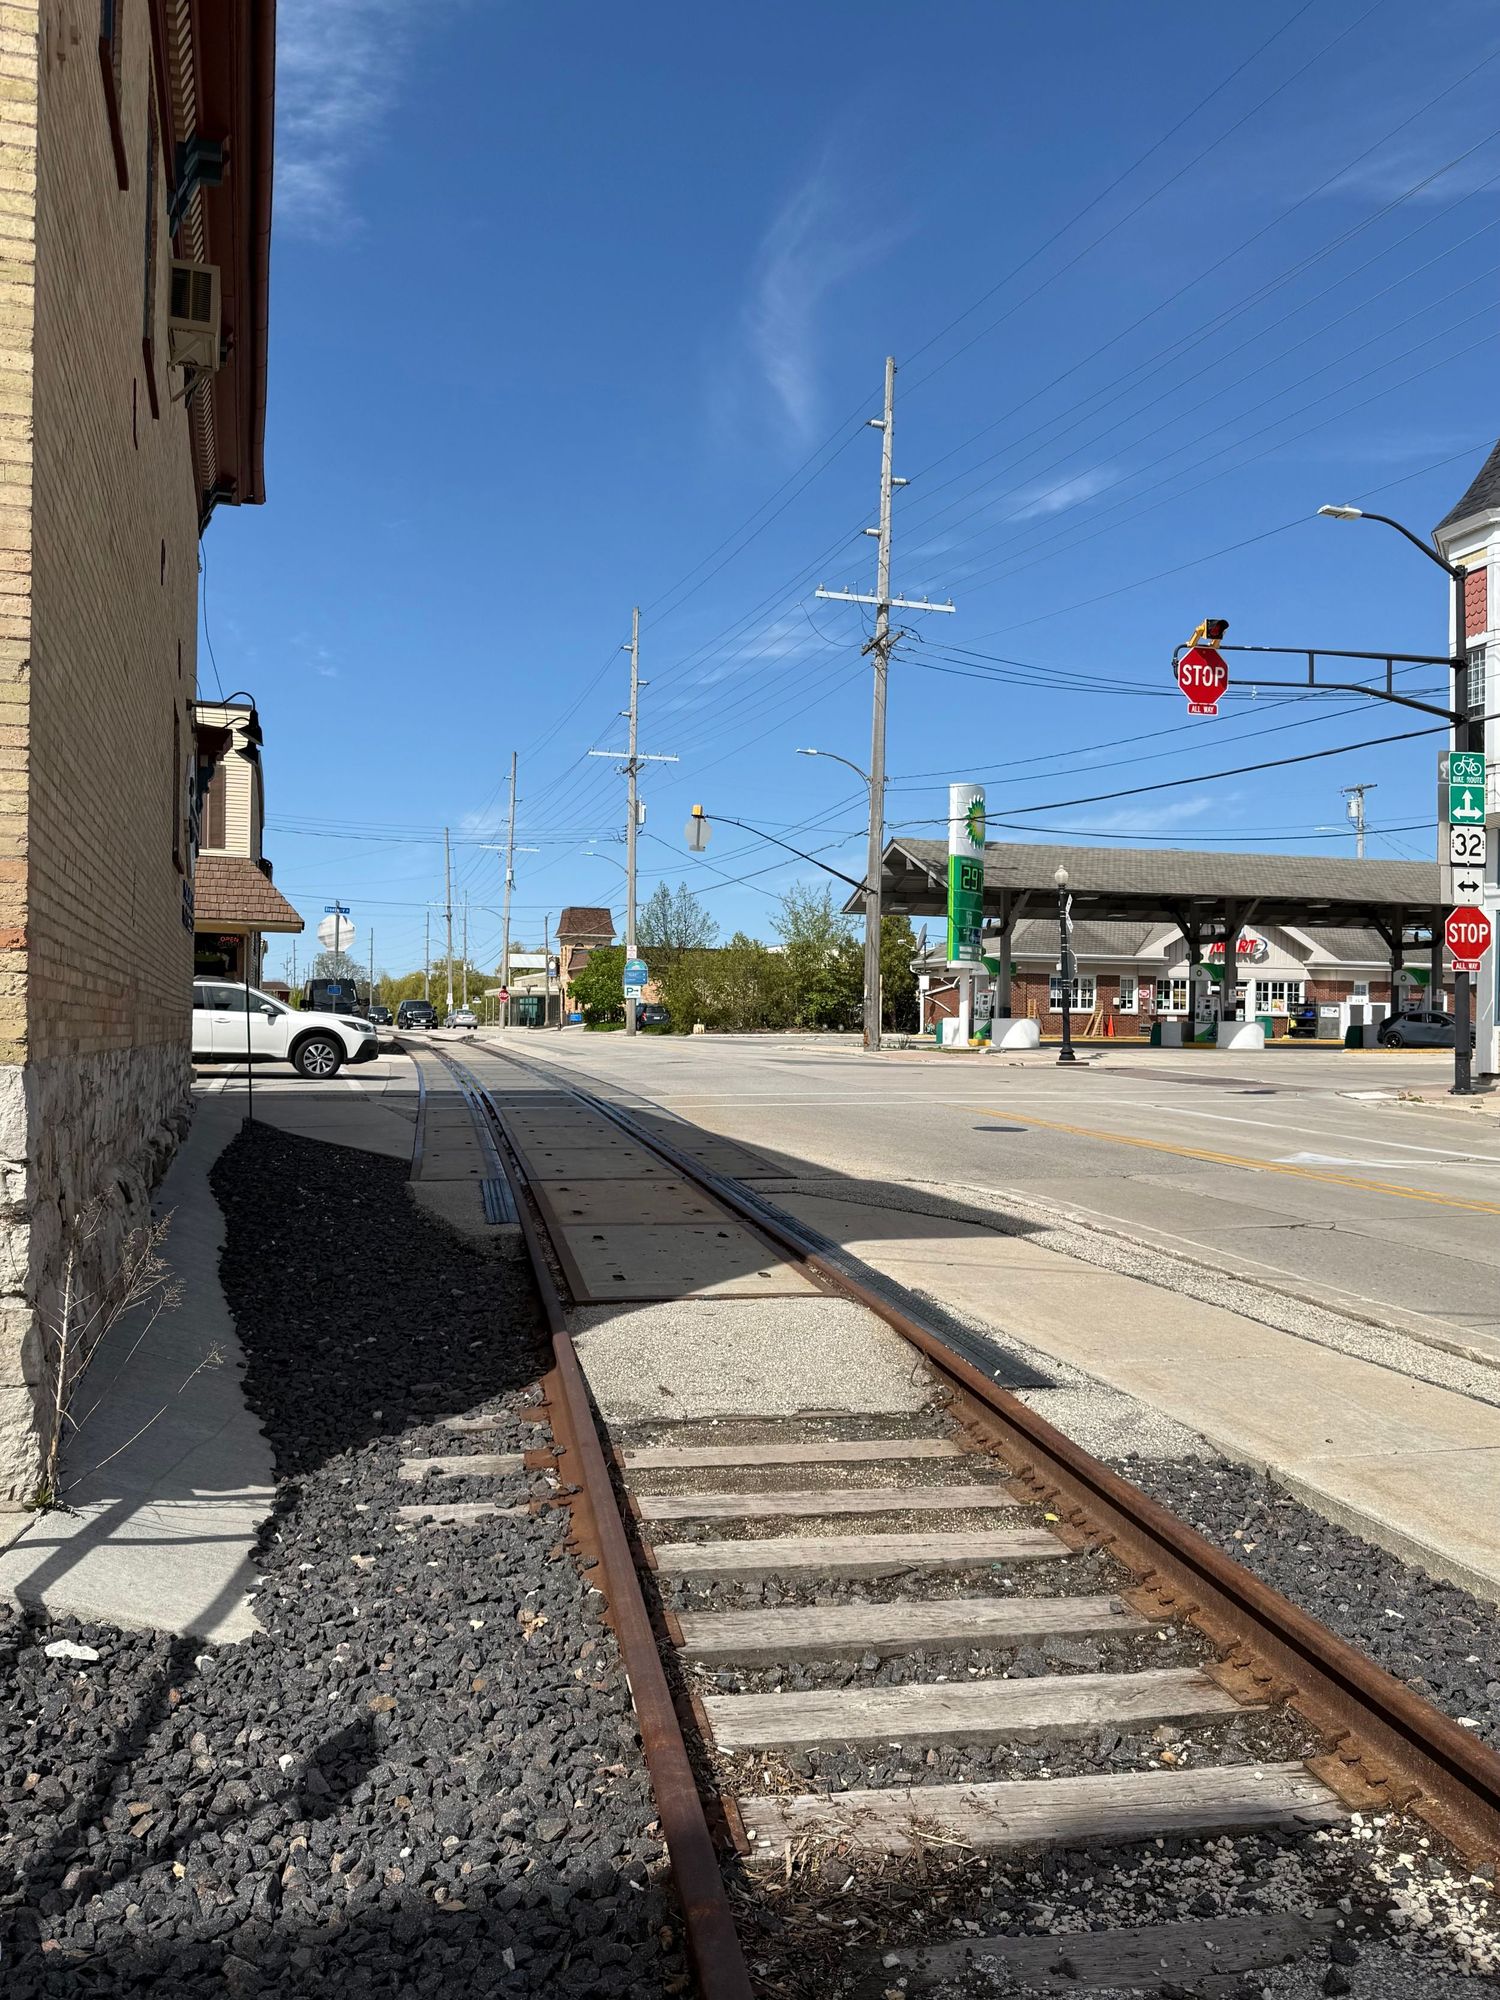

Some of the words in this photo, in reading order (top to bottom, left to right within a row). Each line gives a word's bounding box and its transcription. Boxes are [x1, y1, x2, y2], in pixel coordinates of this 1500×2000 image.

[1181, 664, 1225, 687] STOP
[1191, 705, 1201, 713] ALL
[1452, 775, 1464, 783] BIKE
[1466, 776, 1483, 784] ROUTE
[1455, 833, 1482, 857] 32
[1448, 923, 1489, 943] STOP
[1210, 940, 1257, 954] MRT
